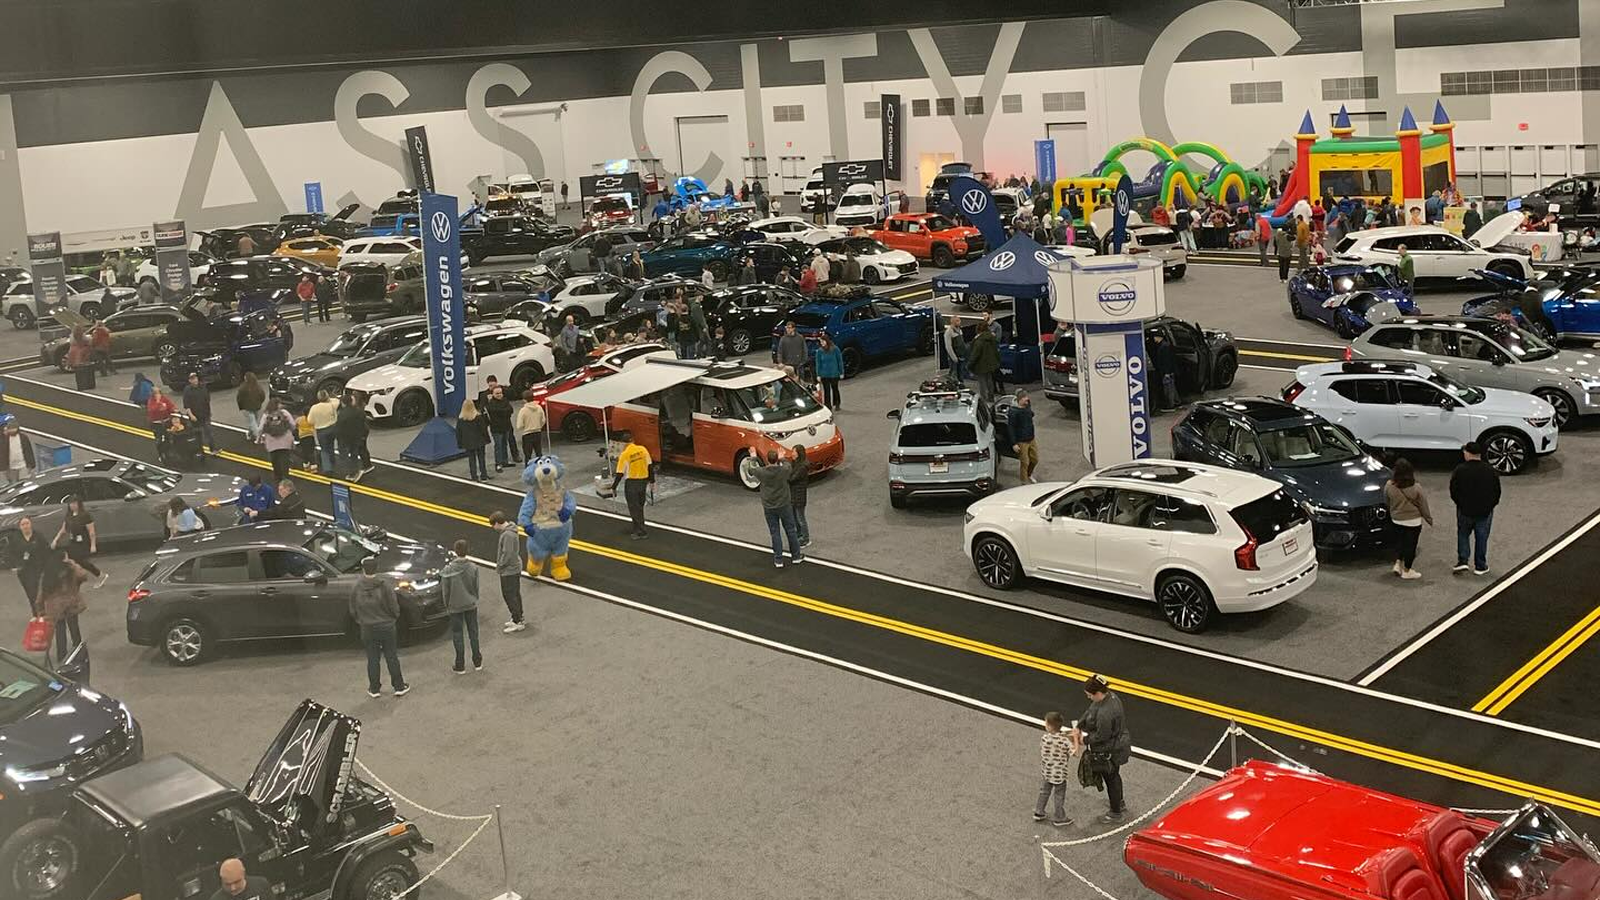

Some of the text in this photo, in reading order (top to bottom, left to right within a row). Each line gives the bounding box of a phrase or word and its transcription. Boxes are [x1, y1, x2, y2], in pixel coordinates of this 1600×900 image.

[629, 22, 1026, 186] CITY
[419, 155, 432, 193] CHEVROLE
[438, 256, 456, 394] Volkswagen
[1101, 292, 1134, 300] VOLVO
[1128, 355, 1148, 459] VOLVO
[326, 732, 358, 824] SCRAMBLER
